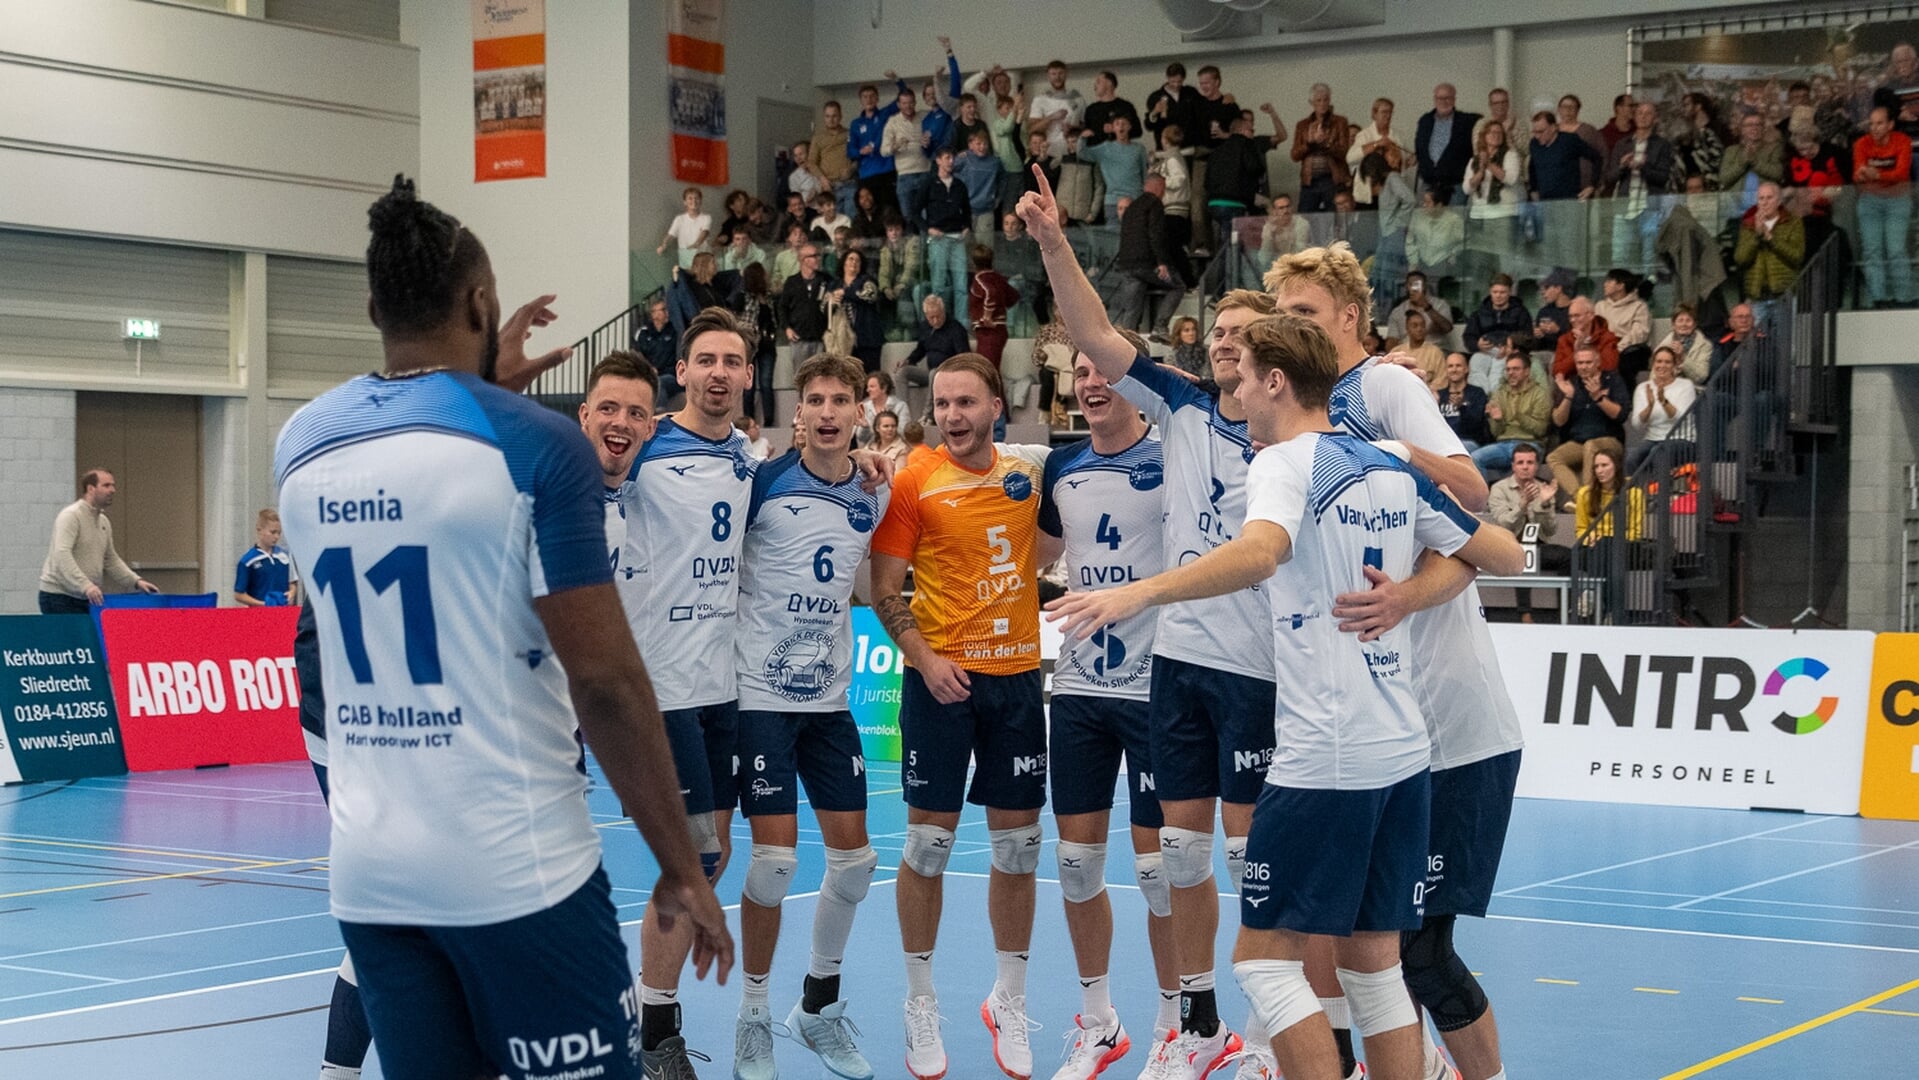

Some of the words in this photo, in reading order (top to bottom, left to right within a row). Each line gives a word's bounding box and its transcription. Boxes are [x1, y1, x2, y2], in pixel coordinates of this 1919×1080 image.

[318, 488, 403, 524] Isenia
[711, 502, 732, 542] 8
[1095, 513, 1122, 550] 4
[1525, 525, 1537, 538] 0
[986, 525, 1013, 564] 5
[812, 545, 835, 583] 6
[1524, 549, 1534, 569] 0
[1094, 566, 1141, 584] VDL
[312, 545, 443, 685] 11
[806, 596, 842, 615] VDL
[4, 648, 75, 667] Kerkbuurt
[76, 648, 96, 665] 91
[1110, 652, 1152, 689] Sliedrecht
[20, 674, 92, 695] Sliedrecht
[127, 659, 227, 718] ARBO
[14, 701, 108, 723] 0184-412856
[337, 703, 373, 727] CAB
[377, 703, 463, 729] holland
[18, 727, 116, 751] www.sjeun.nl
[425, 732, 453, 748] ICT
[754, 754, 766, 771] 6
[908, 750, 918, 767] 5
[1590, 761, 1776, 786] PERSONEEL
[529, 1026, 613, 1068] VDL
